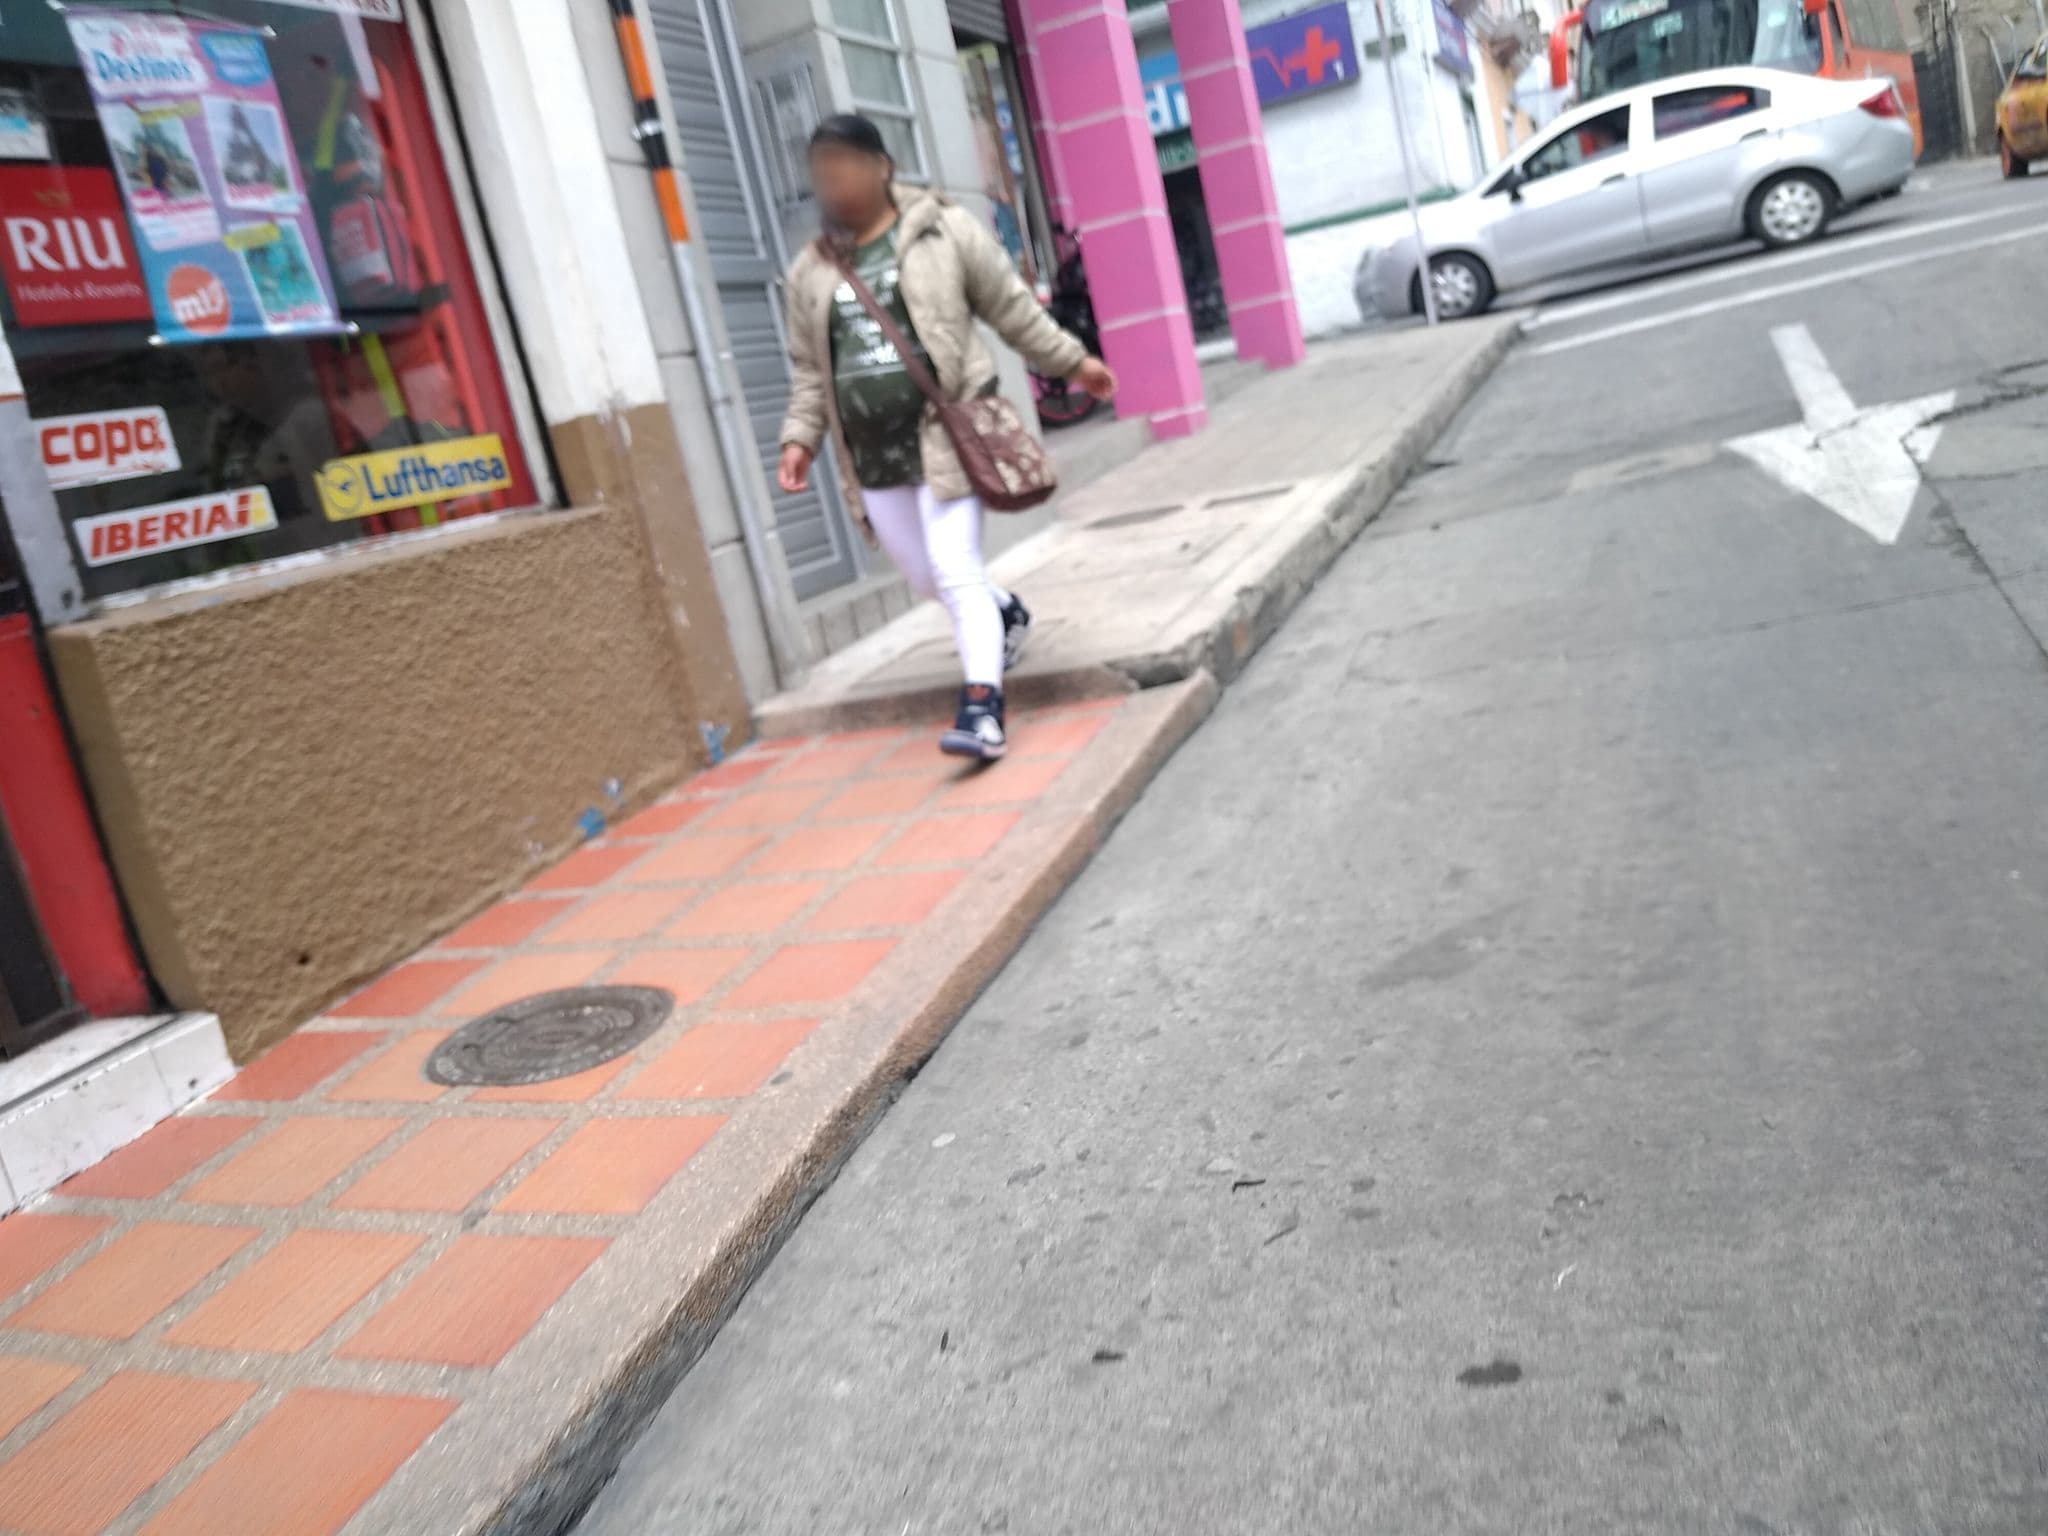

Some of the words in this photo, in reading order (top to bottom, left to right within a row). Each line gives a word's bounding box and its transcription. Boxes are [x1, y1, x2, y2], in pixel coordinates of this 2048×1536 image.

[4, 215, 126, 272] RIU
[361, 455, 506, 501] Lufthansa
[91, 503, 233, 560] IBERIA
